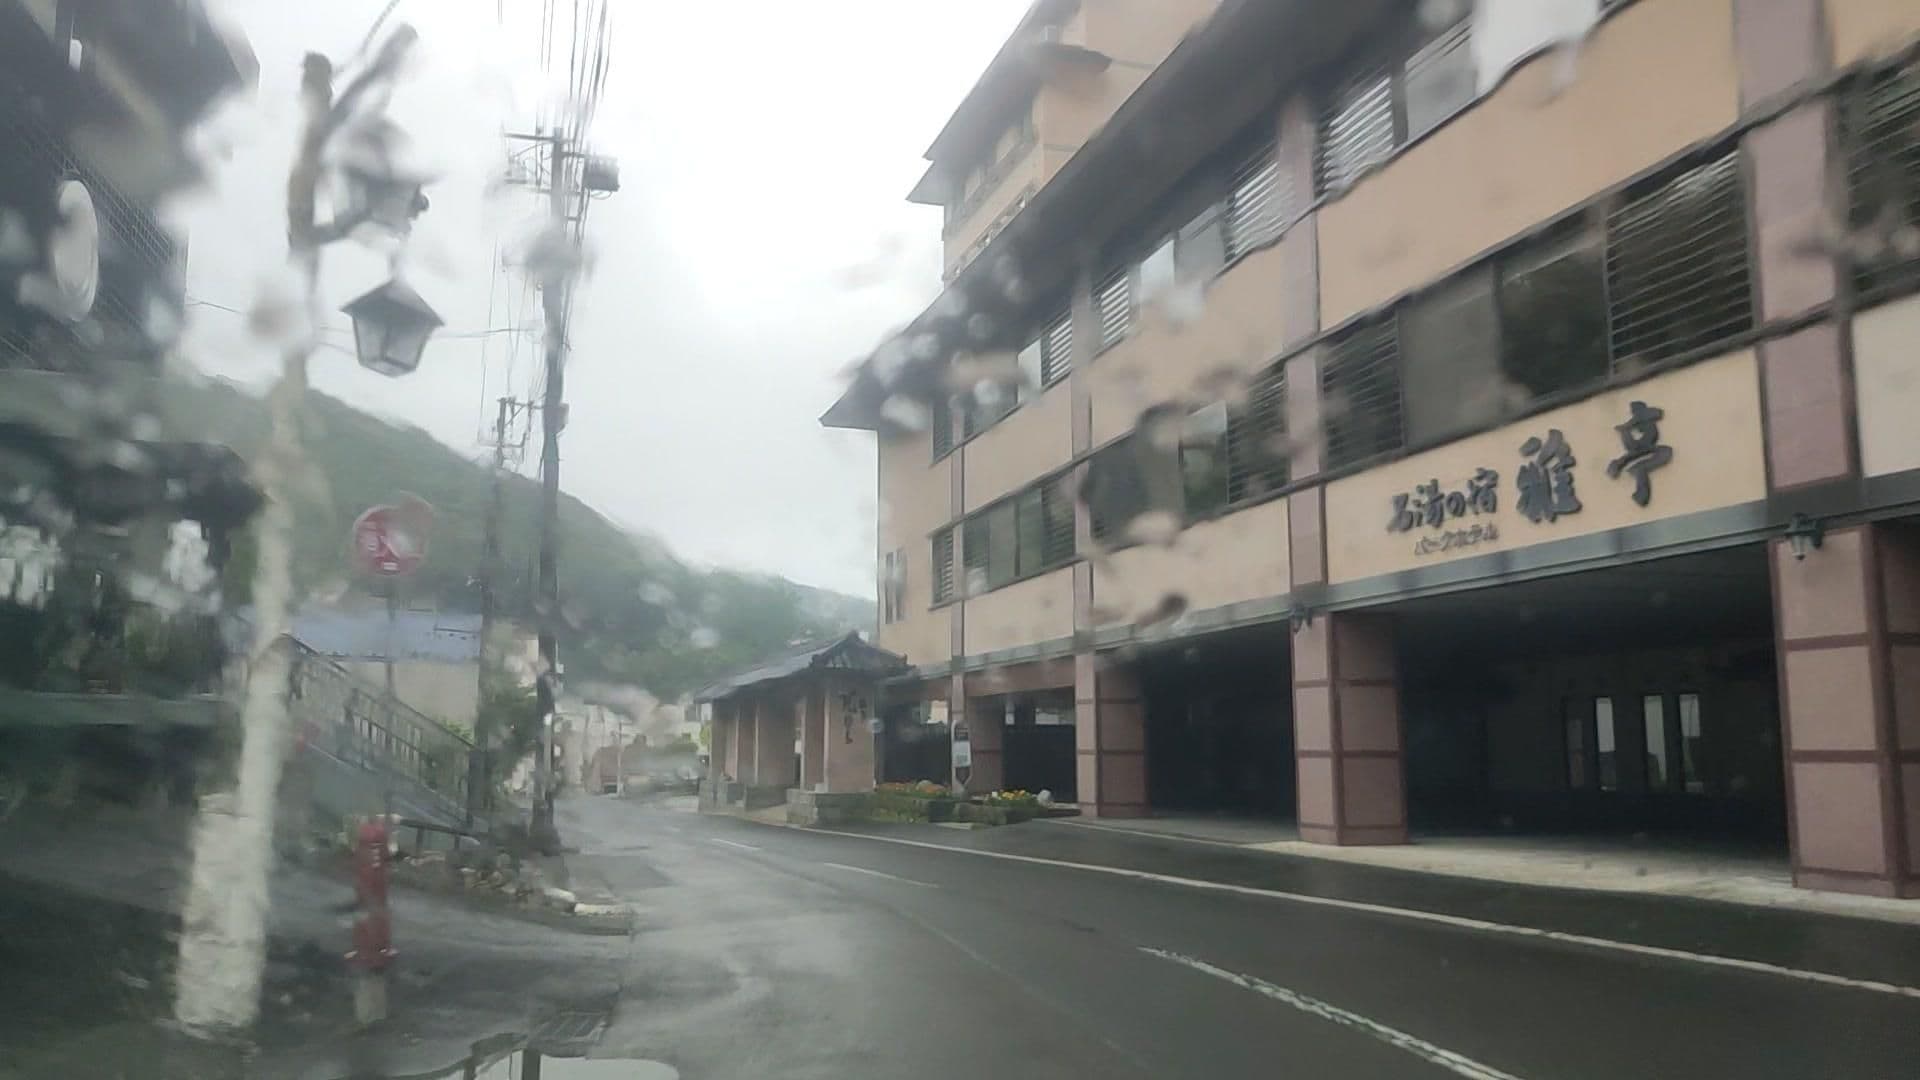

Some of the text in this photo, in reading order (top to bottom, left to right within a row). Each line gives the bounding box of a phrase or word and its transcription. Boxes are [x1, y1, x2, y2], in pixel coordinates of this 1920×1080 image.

[1516, 400, 1673, 524] 雅亭
[1414, 521, 1499, 556] パークホテル
